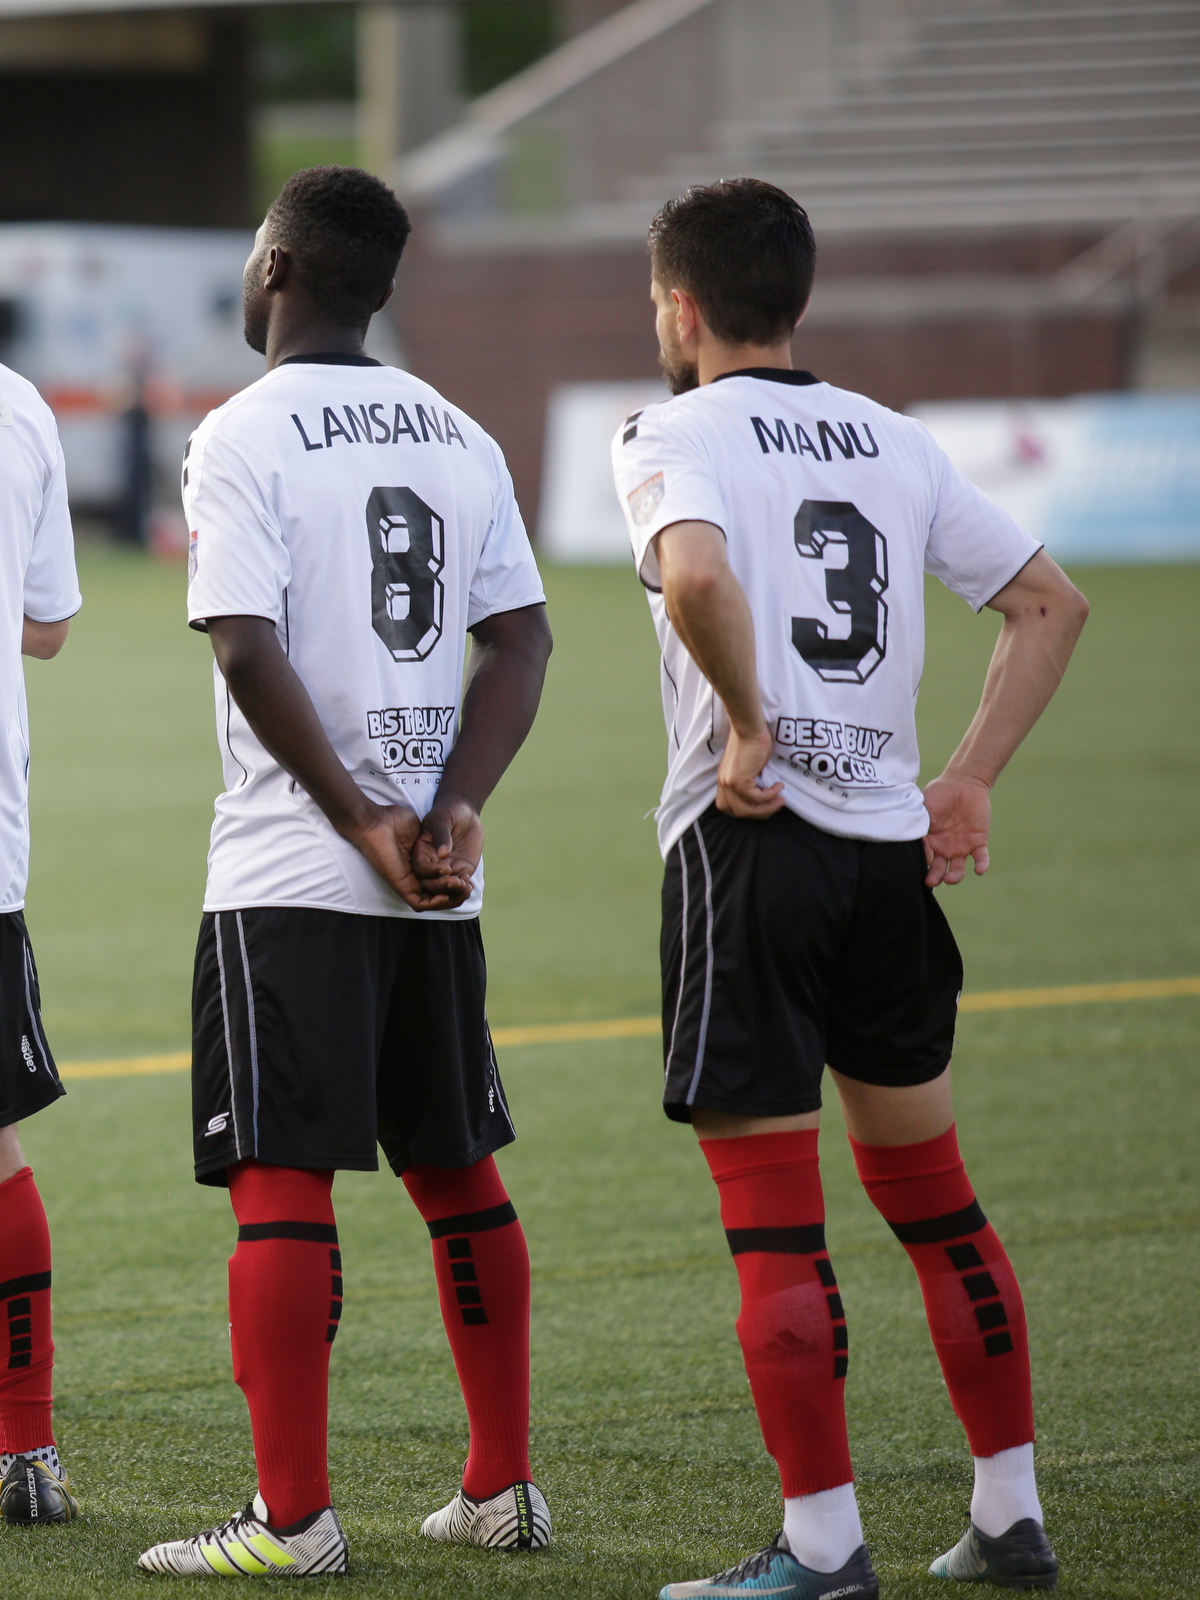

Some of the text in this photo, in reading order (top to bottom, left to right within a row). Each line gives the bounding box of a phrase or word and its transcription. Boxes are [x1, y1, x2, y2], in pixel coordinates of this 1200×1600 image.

[291, 403, 468, 451] LANSANA
[750, 416, 880, 462] MANU
[366, 487, 444, 663] 8
[791, 499, 889, 685] 3
[412, 706, 455, 735] BUY
[776, 716, 894, 759] BEST BUY
[515, 1484, 528, 1528] NEMEZIZ
[818, 1582, 866, 1600] MERCURIAL
